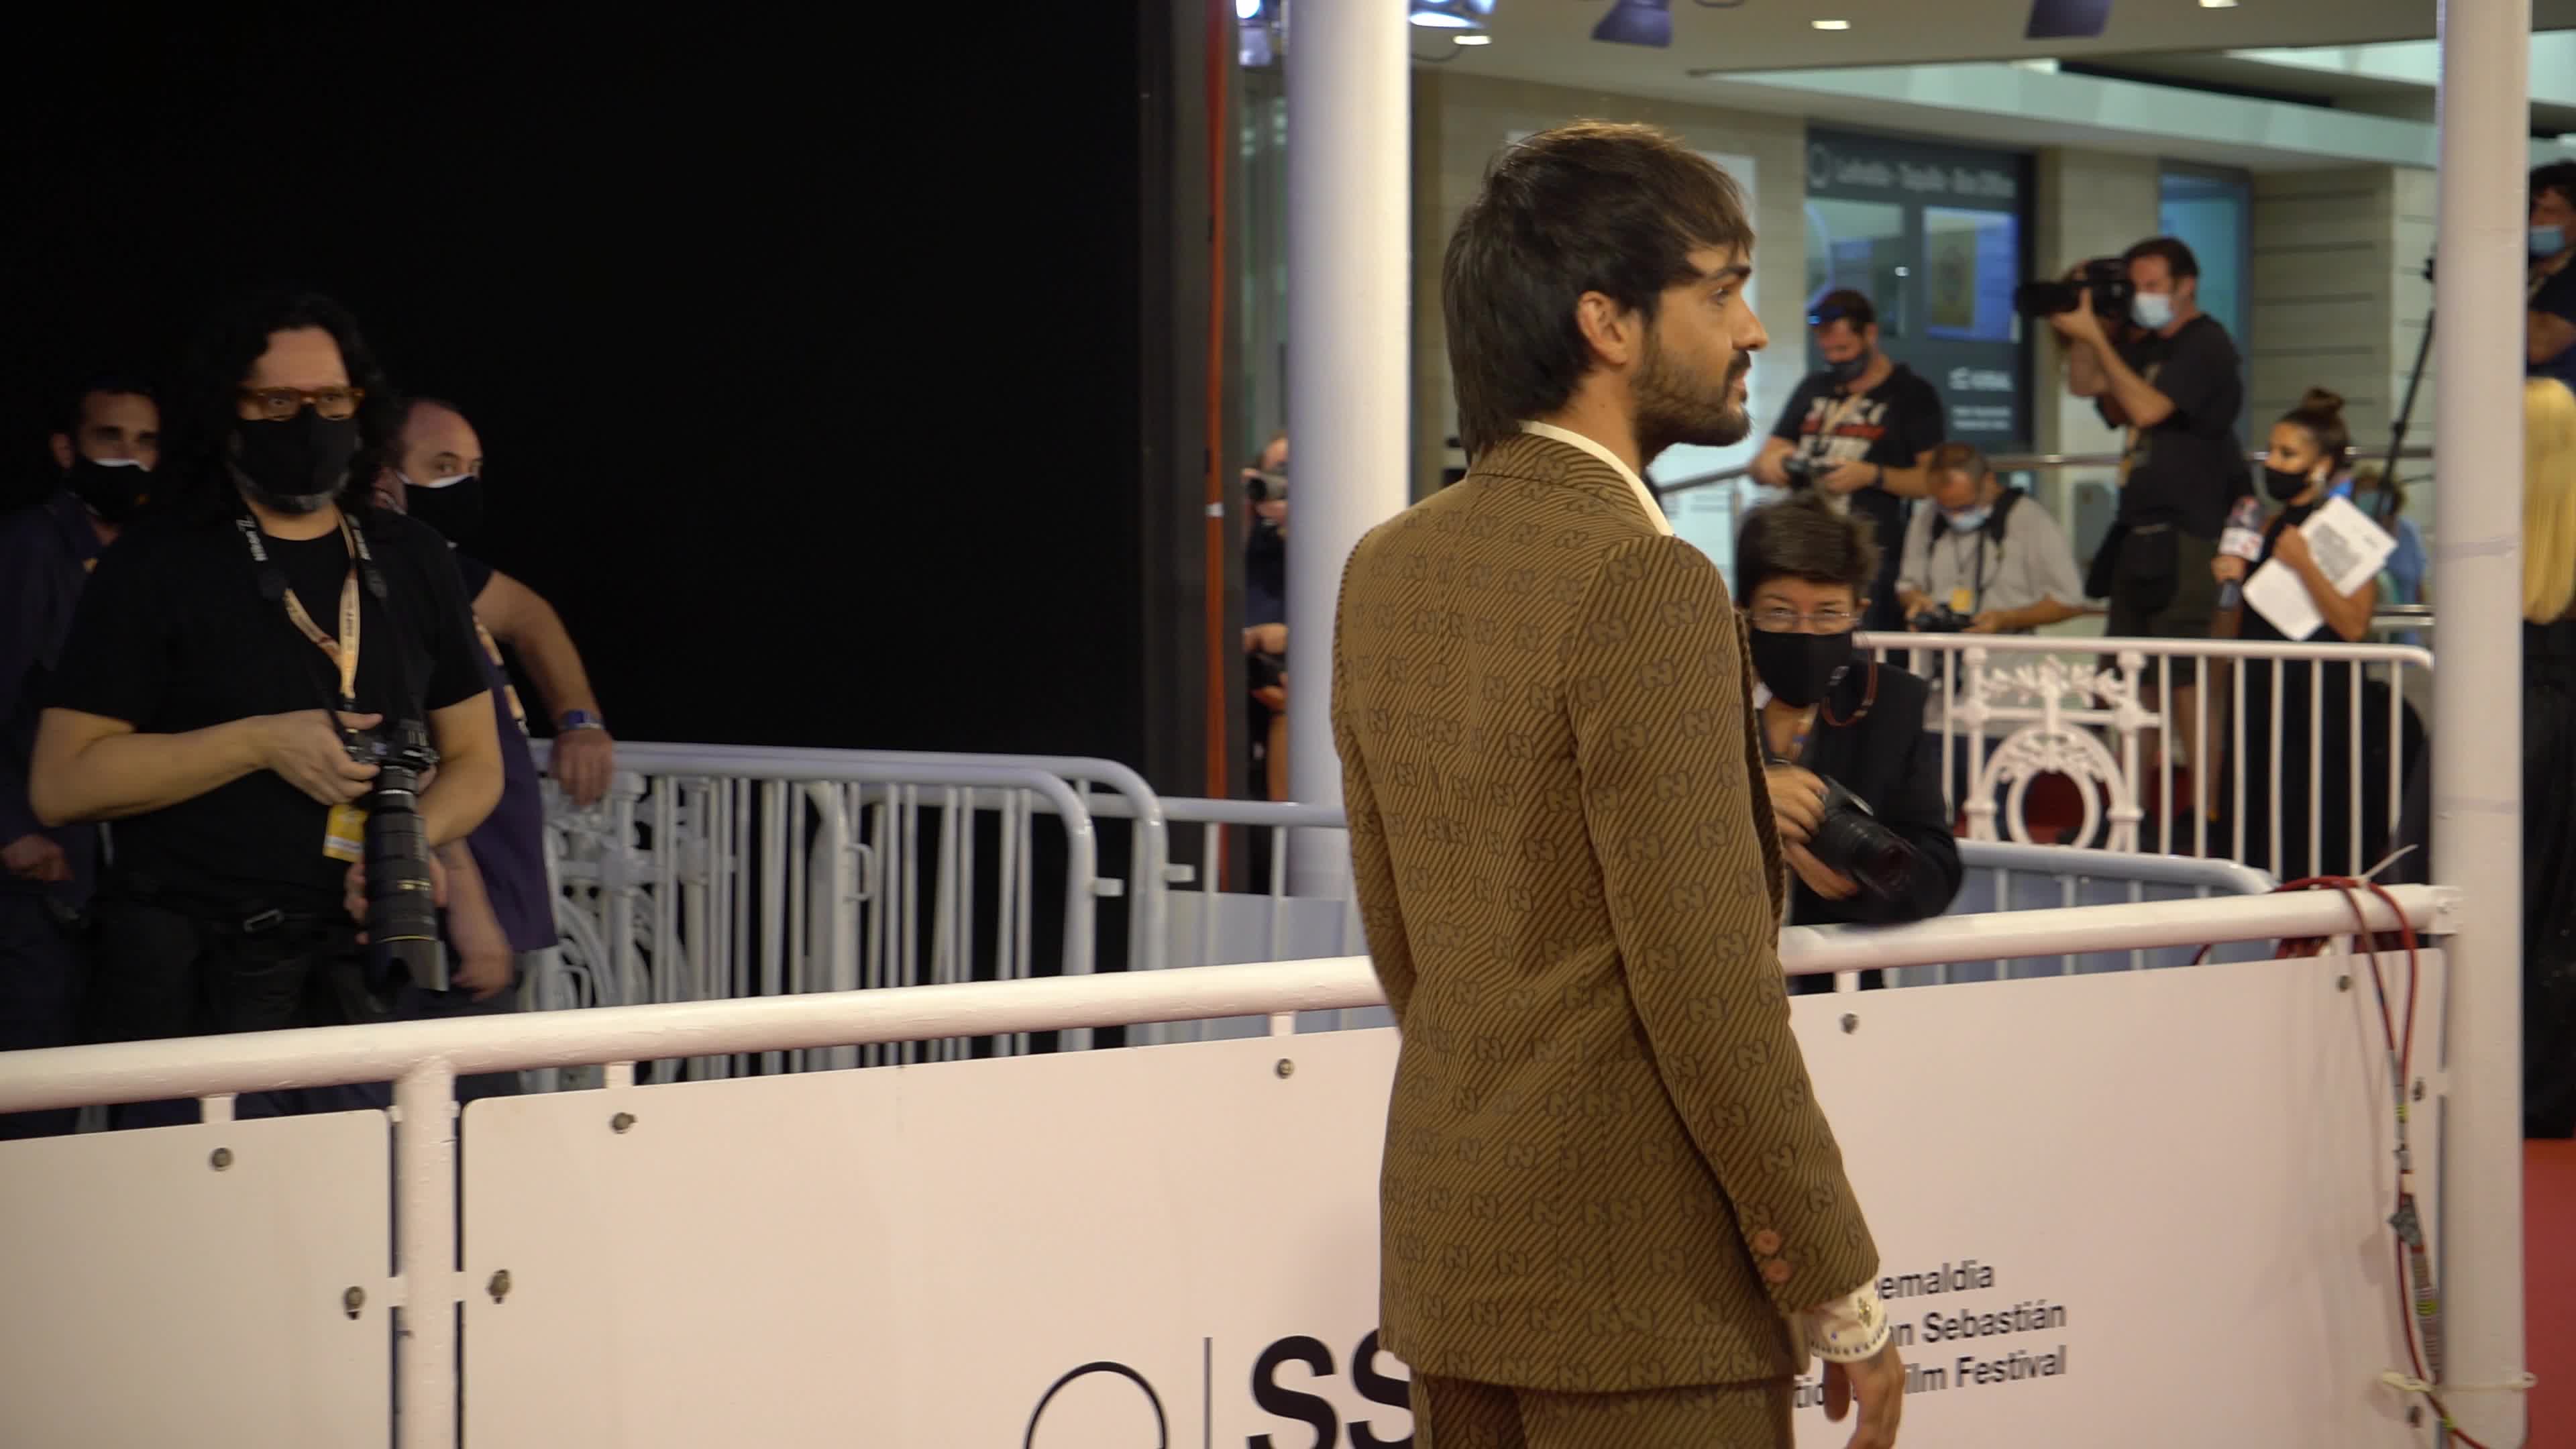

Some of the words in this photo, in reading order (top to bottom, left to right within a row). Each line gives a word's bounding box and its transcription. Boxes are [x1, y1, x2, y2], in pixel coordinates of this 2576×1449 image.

[1878, 1260, 1994, 1299] emaldia
[1922, 1299, 2066, 1342] Sebastián
[1905, 1362, 1947, 1395] ilm
[1955, 1345, 2066, 1387] Festival
